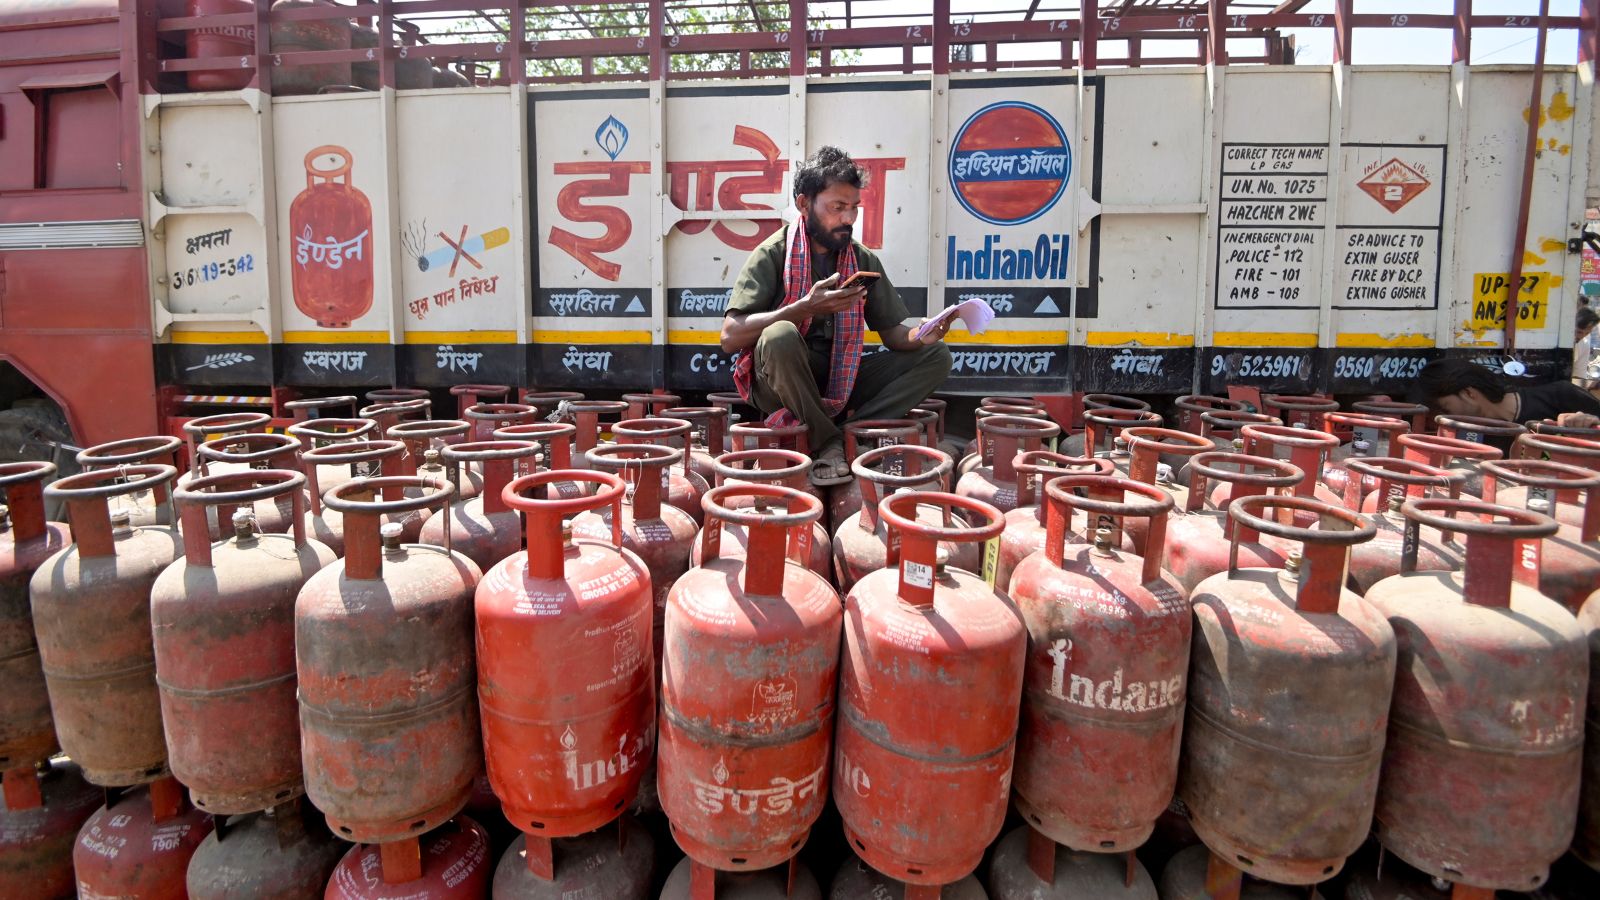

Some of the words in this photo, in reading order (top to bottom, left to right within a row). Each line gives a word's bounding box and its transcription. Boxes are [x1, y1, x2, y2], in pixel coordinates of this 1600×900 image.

[1050, 20, 1068, 31] 14
[1103, 18, 1120, 31] 15
[1178, 15, 1196, 28] 16
[1231, 15, 1247, 27] 17
[1309, 15, 1323, 26] 18
[1391, 15, 1408, 26] 19
[1505, 16, 1530, 26] 20
[906, 27, 921, 38] 12
[953, 24, 971, 36] 13
[669, 36, 680, 47] 9
[774, 32, 788, 43] 10
[811, 31, 824, 42] 11
[496, 42, 503, 53] 6
[532, 41, 538, 52] 7
[637, 38, 645, 48] 8
[366, 49, 374, 60] 4
[399, 47, 408, 58] 5
[241, 57, 249, 68] 2
[274, 55, 282, 66] 3
[1227, 148, 1267, 160] CORRECT
[1271, 148, 1296, 160] TECH
[1297, 148, 1325, 160] NAME
[1272, 161, 1294, 170] GAS
[1283, 179, 1316, 195] 1075
[1384, 185, 1403, 201] 2
[1226, 205, 1285, 221] HAZCHEM
[1287, 204, 1317, 221] 2WE
[186, 228, 232, 255] क्षमता
[1292, 232, 1315, 244] DIAL
[1409, 234, 1425, 248] TO
[947, 234, 1069, 280] IndianOil
[1283, 249, 1304, 263] 112
[1344, 251, 1378, 265] EXTIN
[1383, 251, 1420, 265] GUSER
[1234, 268, 1264, 282] FIRE
[1281, 268, 1301, 281] 101
[1350, 268, 1378, 282] FIRE
[1380, 269, 1397, 282] BY
[1229, 286, 1260, 300] AMB
[1279, 286, 1300, 300] 108
[1346, 286, 1387, 300] EXTING
[1390, 286, 1427, 300] GUSHER
[303, 350, 367, 373] स्वराज
[1046, 638, 1183, 713] Indane
